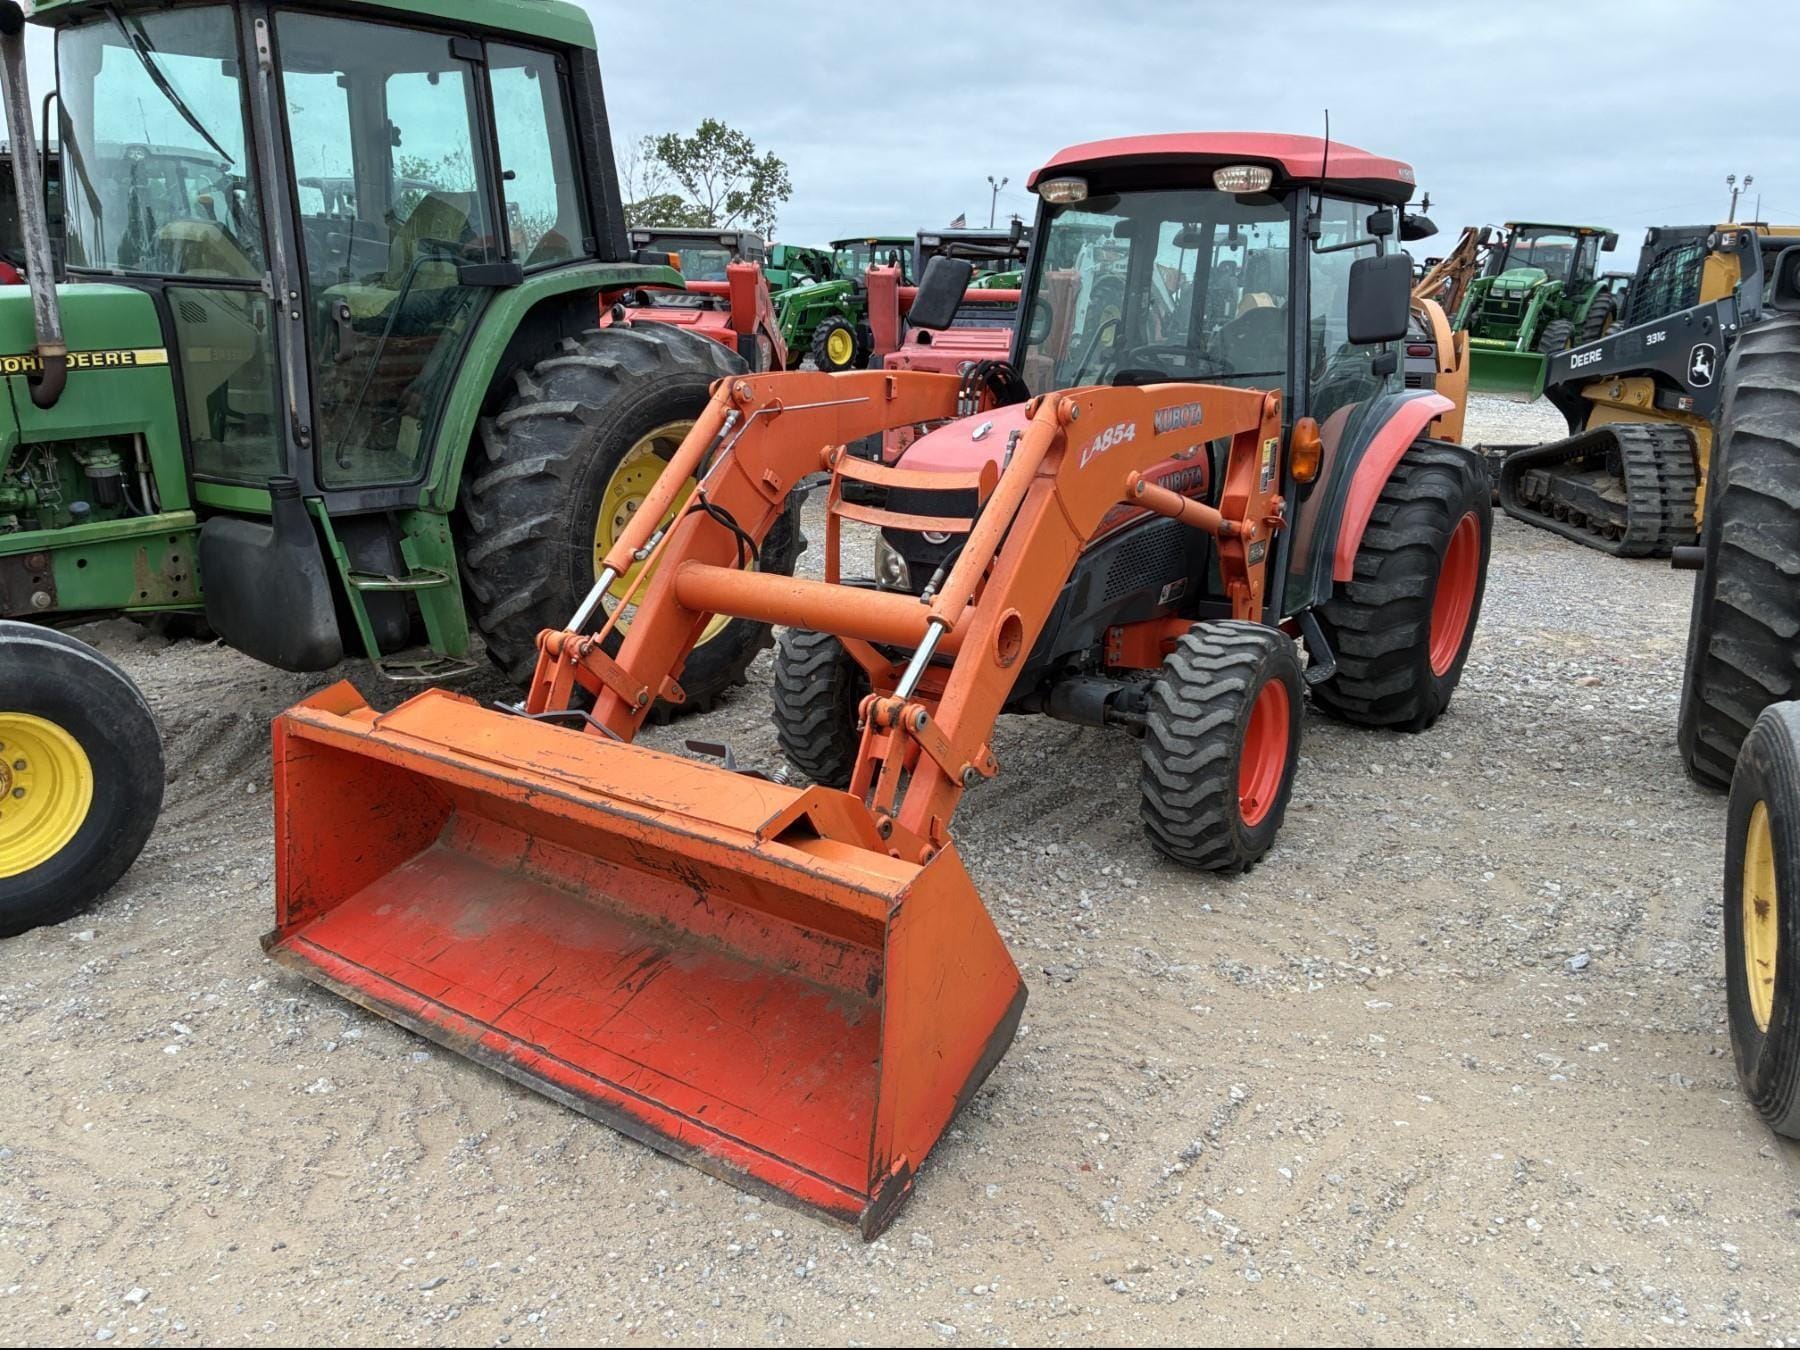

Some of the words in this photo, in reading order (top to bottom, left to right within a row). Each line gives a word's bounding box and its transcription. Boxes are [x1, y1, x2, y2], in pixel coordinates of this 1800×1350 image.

[66, 351, 133, 367] DEERE
[1570, 348, 1602, 369] DEERE
[1154, 402, 1202, 433] KUBOTA
[1079, 423, 1136, 469] LA854
